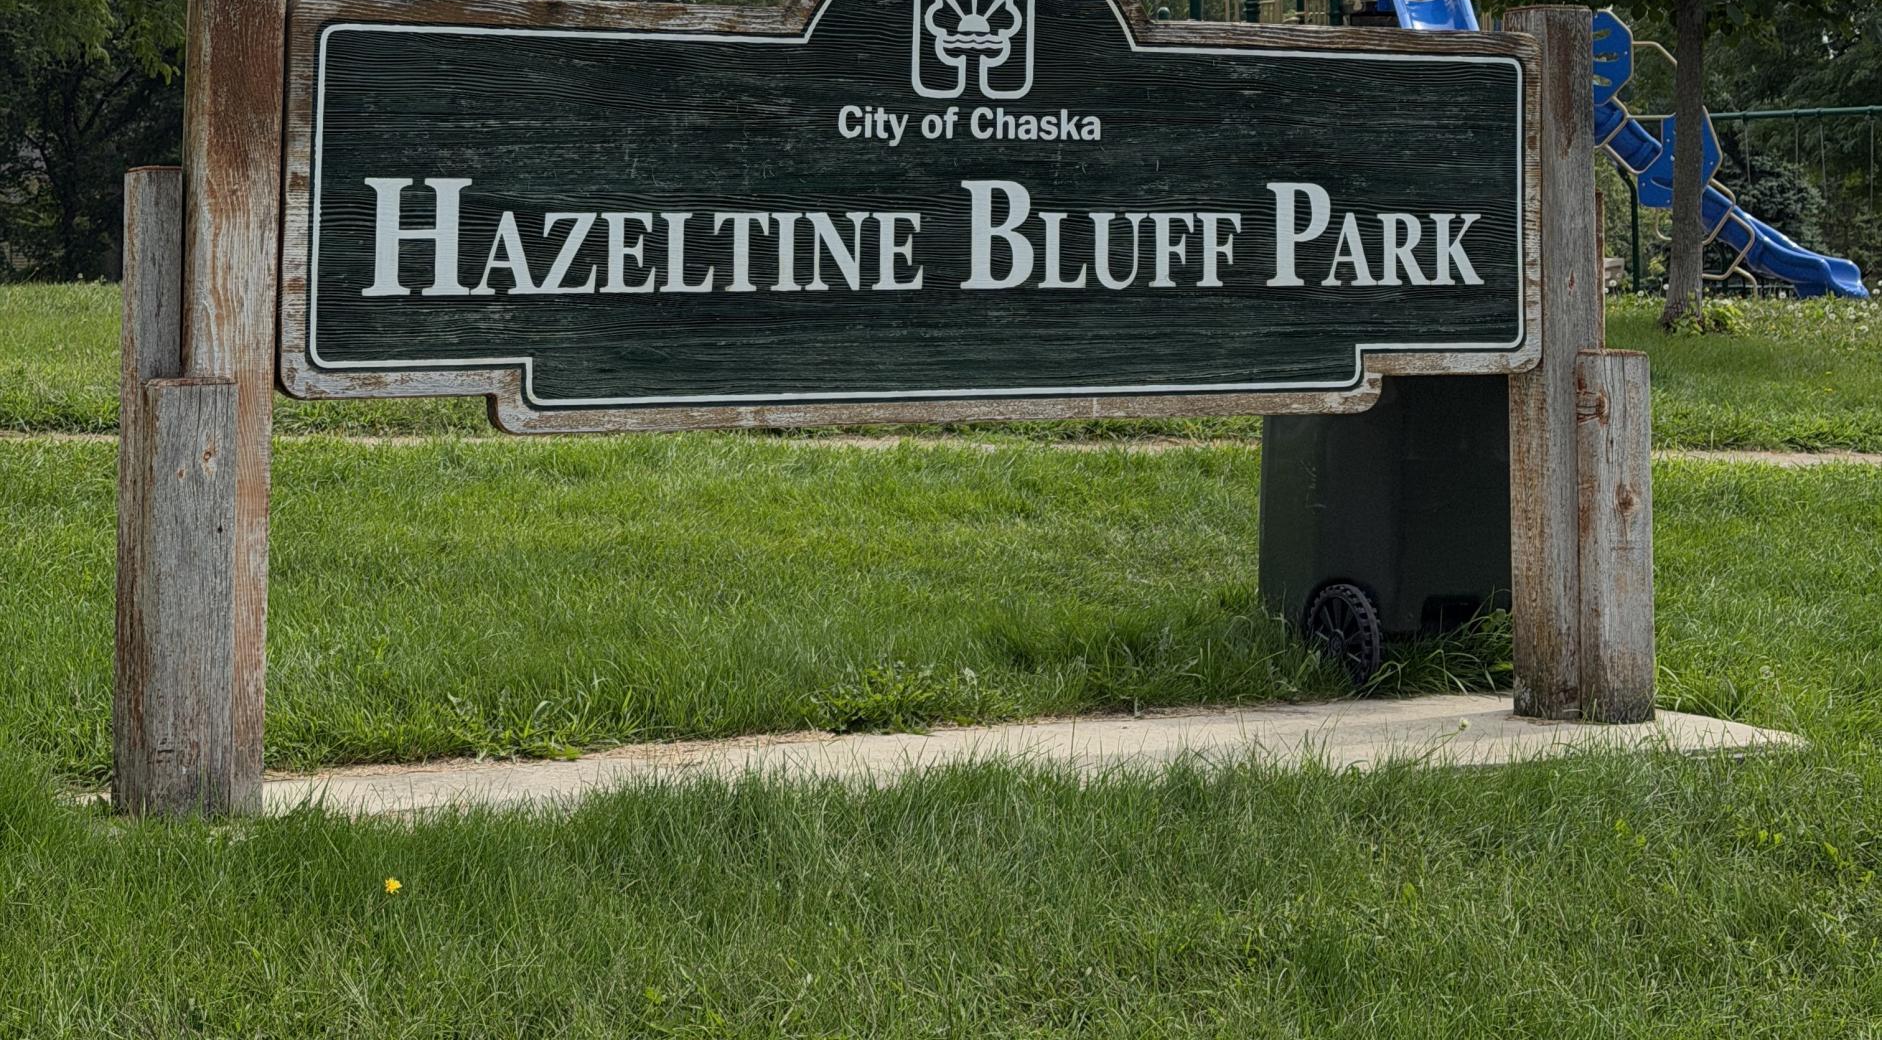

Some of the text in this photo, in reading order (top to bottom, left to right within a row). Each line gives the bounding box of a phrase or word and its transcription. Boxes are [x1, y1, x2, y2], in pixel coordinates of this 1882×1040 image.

[837, 104, 1101, 147] City of Chaska
[360, 176, 1486, 297] HAZELTINE BLUFF PARK
